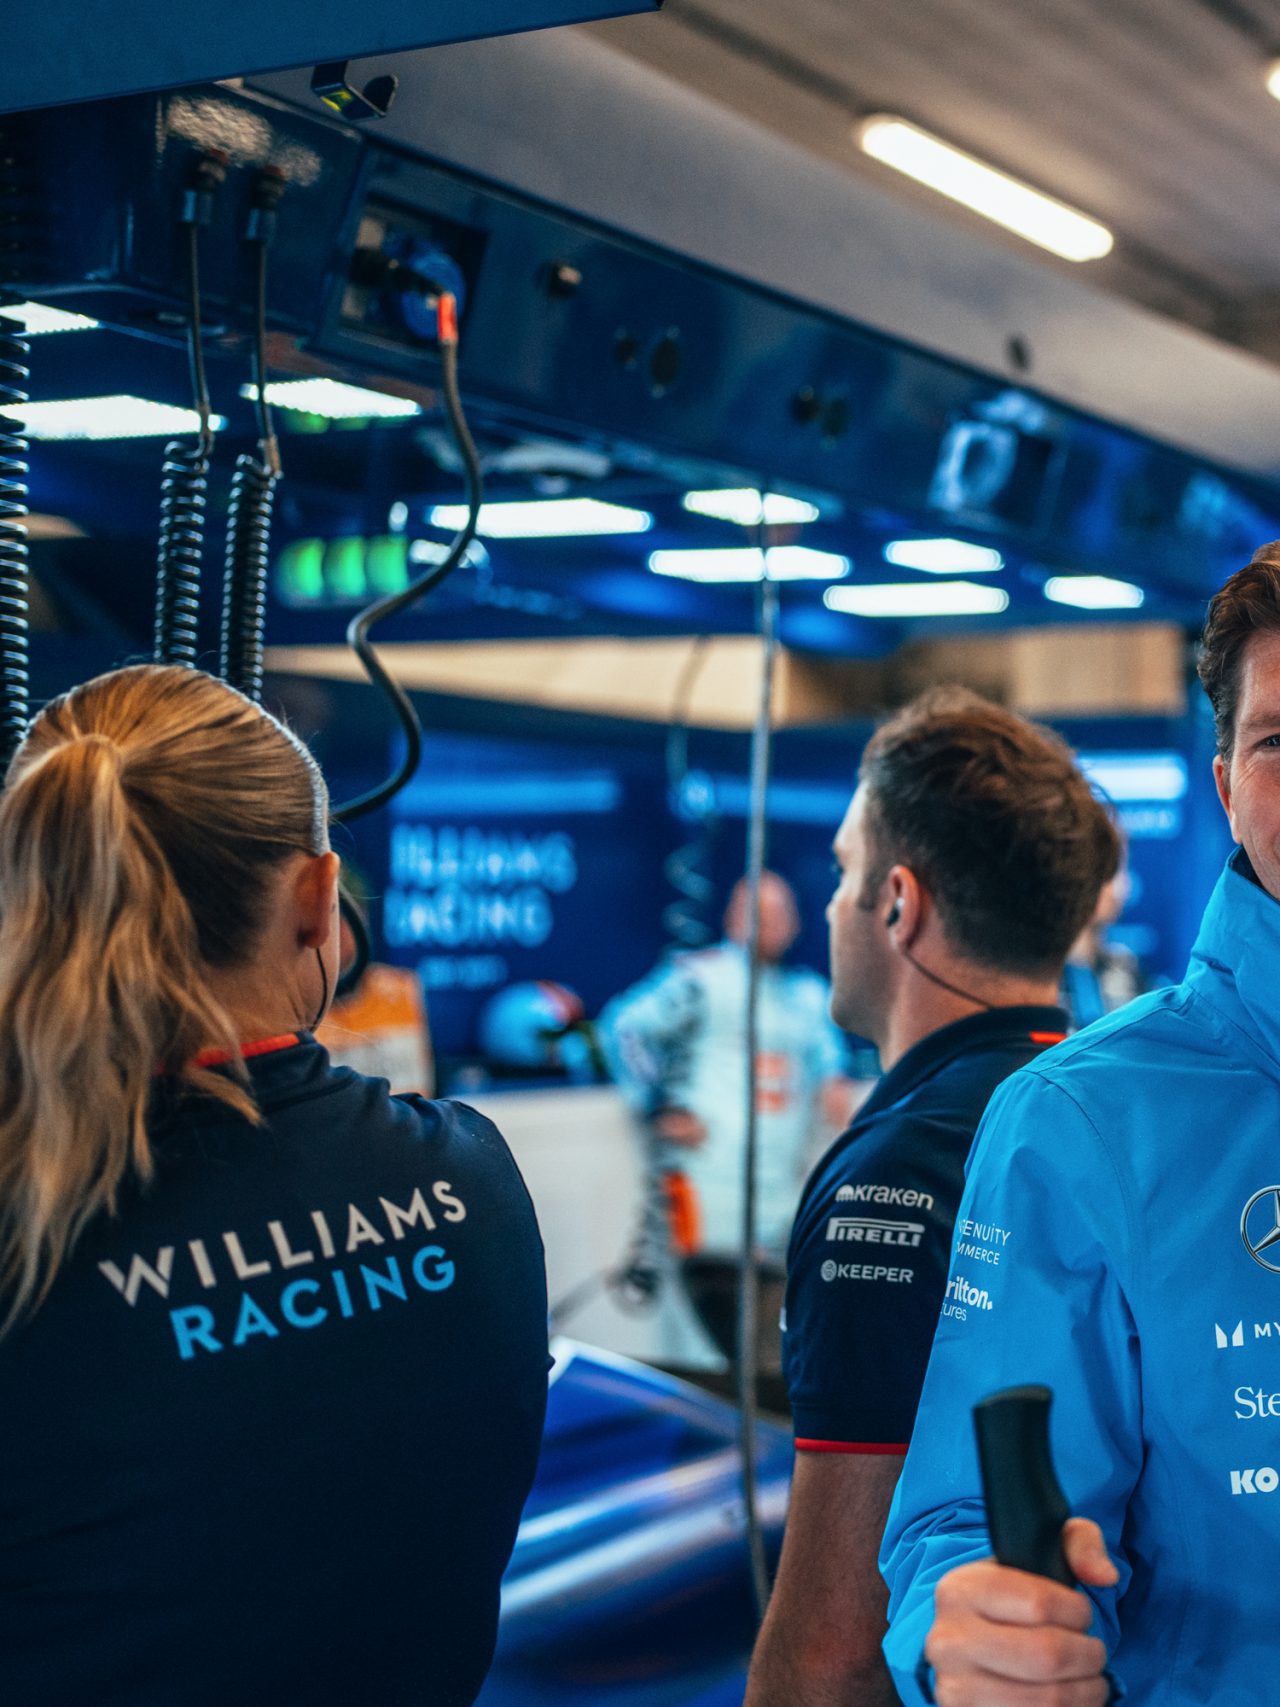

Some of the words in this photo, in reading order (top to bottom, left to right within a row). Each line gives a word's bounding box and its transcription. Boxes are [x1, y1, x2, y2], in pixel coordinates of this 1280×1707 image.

[97, 1180, 468, 1307] WILLIAMS
[826, 1217, 925, 1247] PIRELLI
[956, 1242, 1000, 1265] MMERCE
[837, 1263, 914, 1283] KEEPER
[169, 1244, 457, 1359] RACING
[945, 1276, 993, 1310] rilton.
